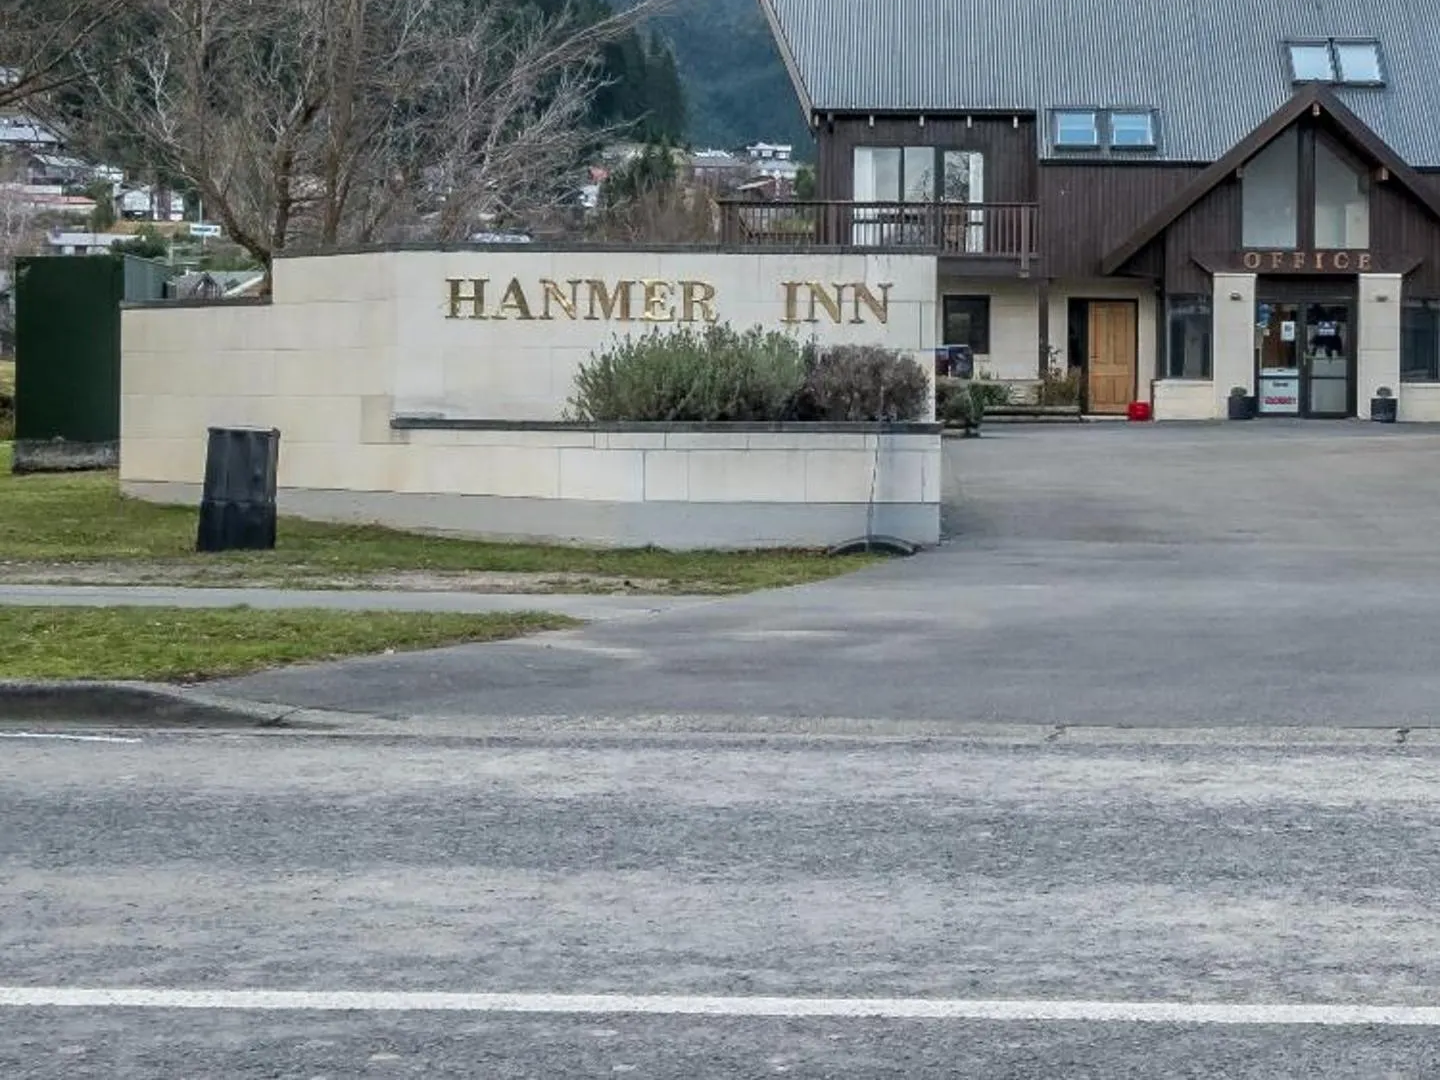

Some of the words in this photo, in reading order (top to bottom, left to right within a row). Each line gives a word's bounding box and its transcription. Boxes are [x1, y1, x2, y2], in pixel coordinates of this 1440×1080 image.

[1243, 251, 1373, 270] OFFICE
[445, 276, 720, 323] HANMER
[779, 280, 894, 325] INN
